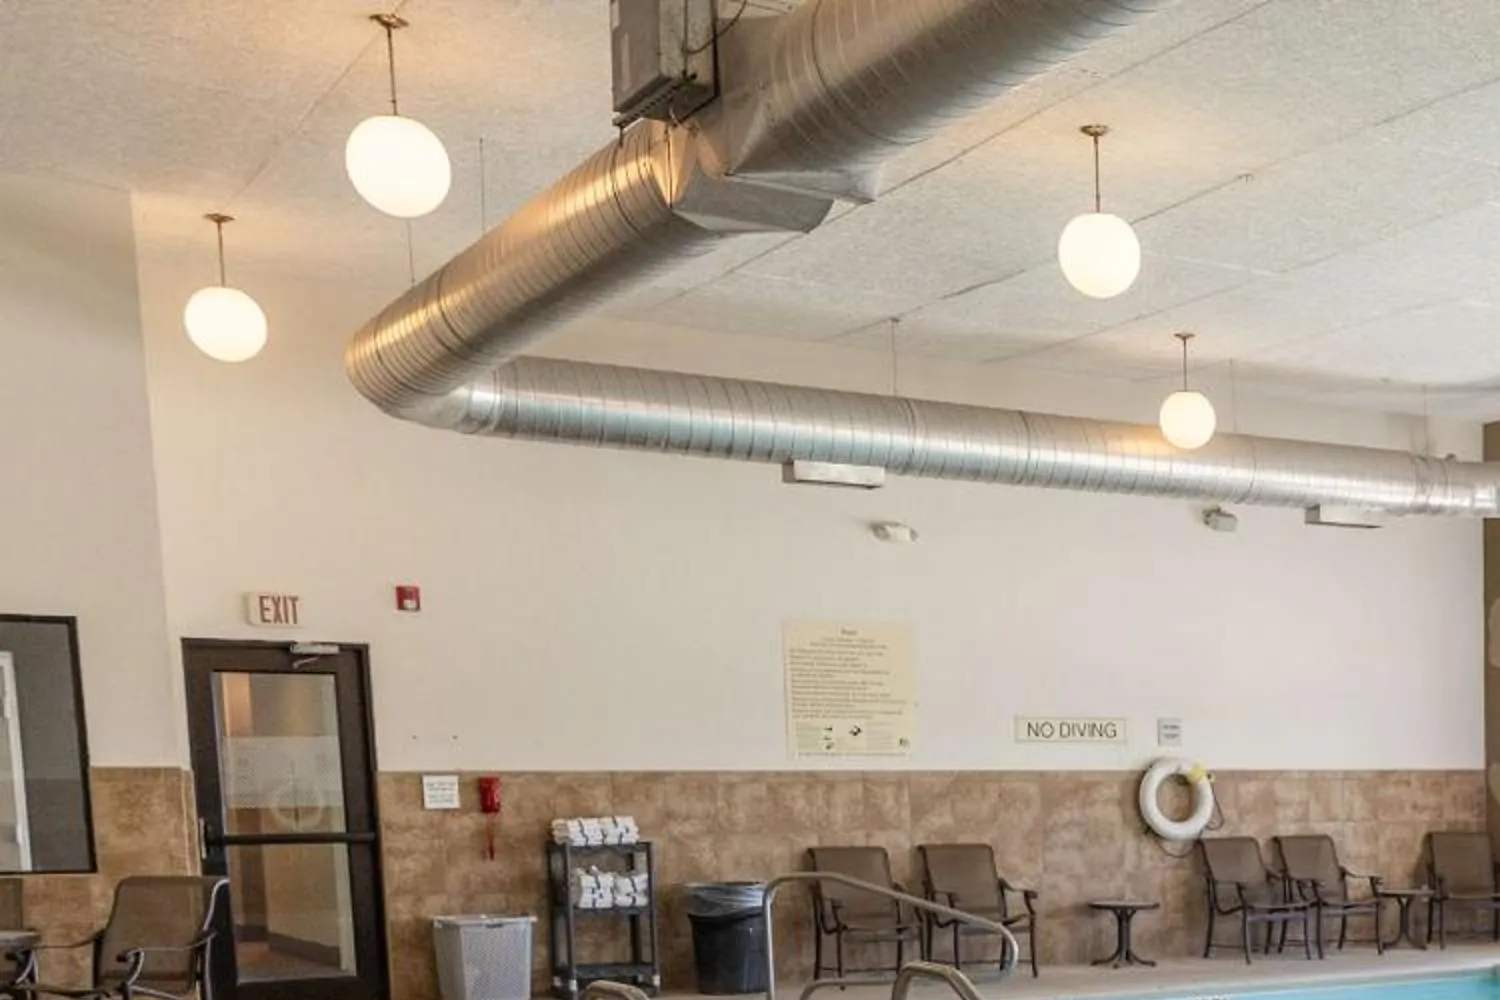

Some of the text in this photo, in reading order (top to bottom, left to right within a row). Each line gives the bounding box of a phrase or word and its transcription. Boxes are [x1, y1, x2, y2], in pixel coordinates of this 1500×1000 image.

[259, 595, 299, 625] EXIT
[1027, 722, 1117, 738] NO DIVING
